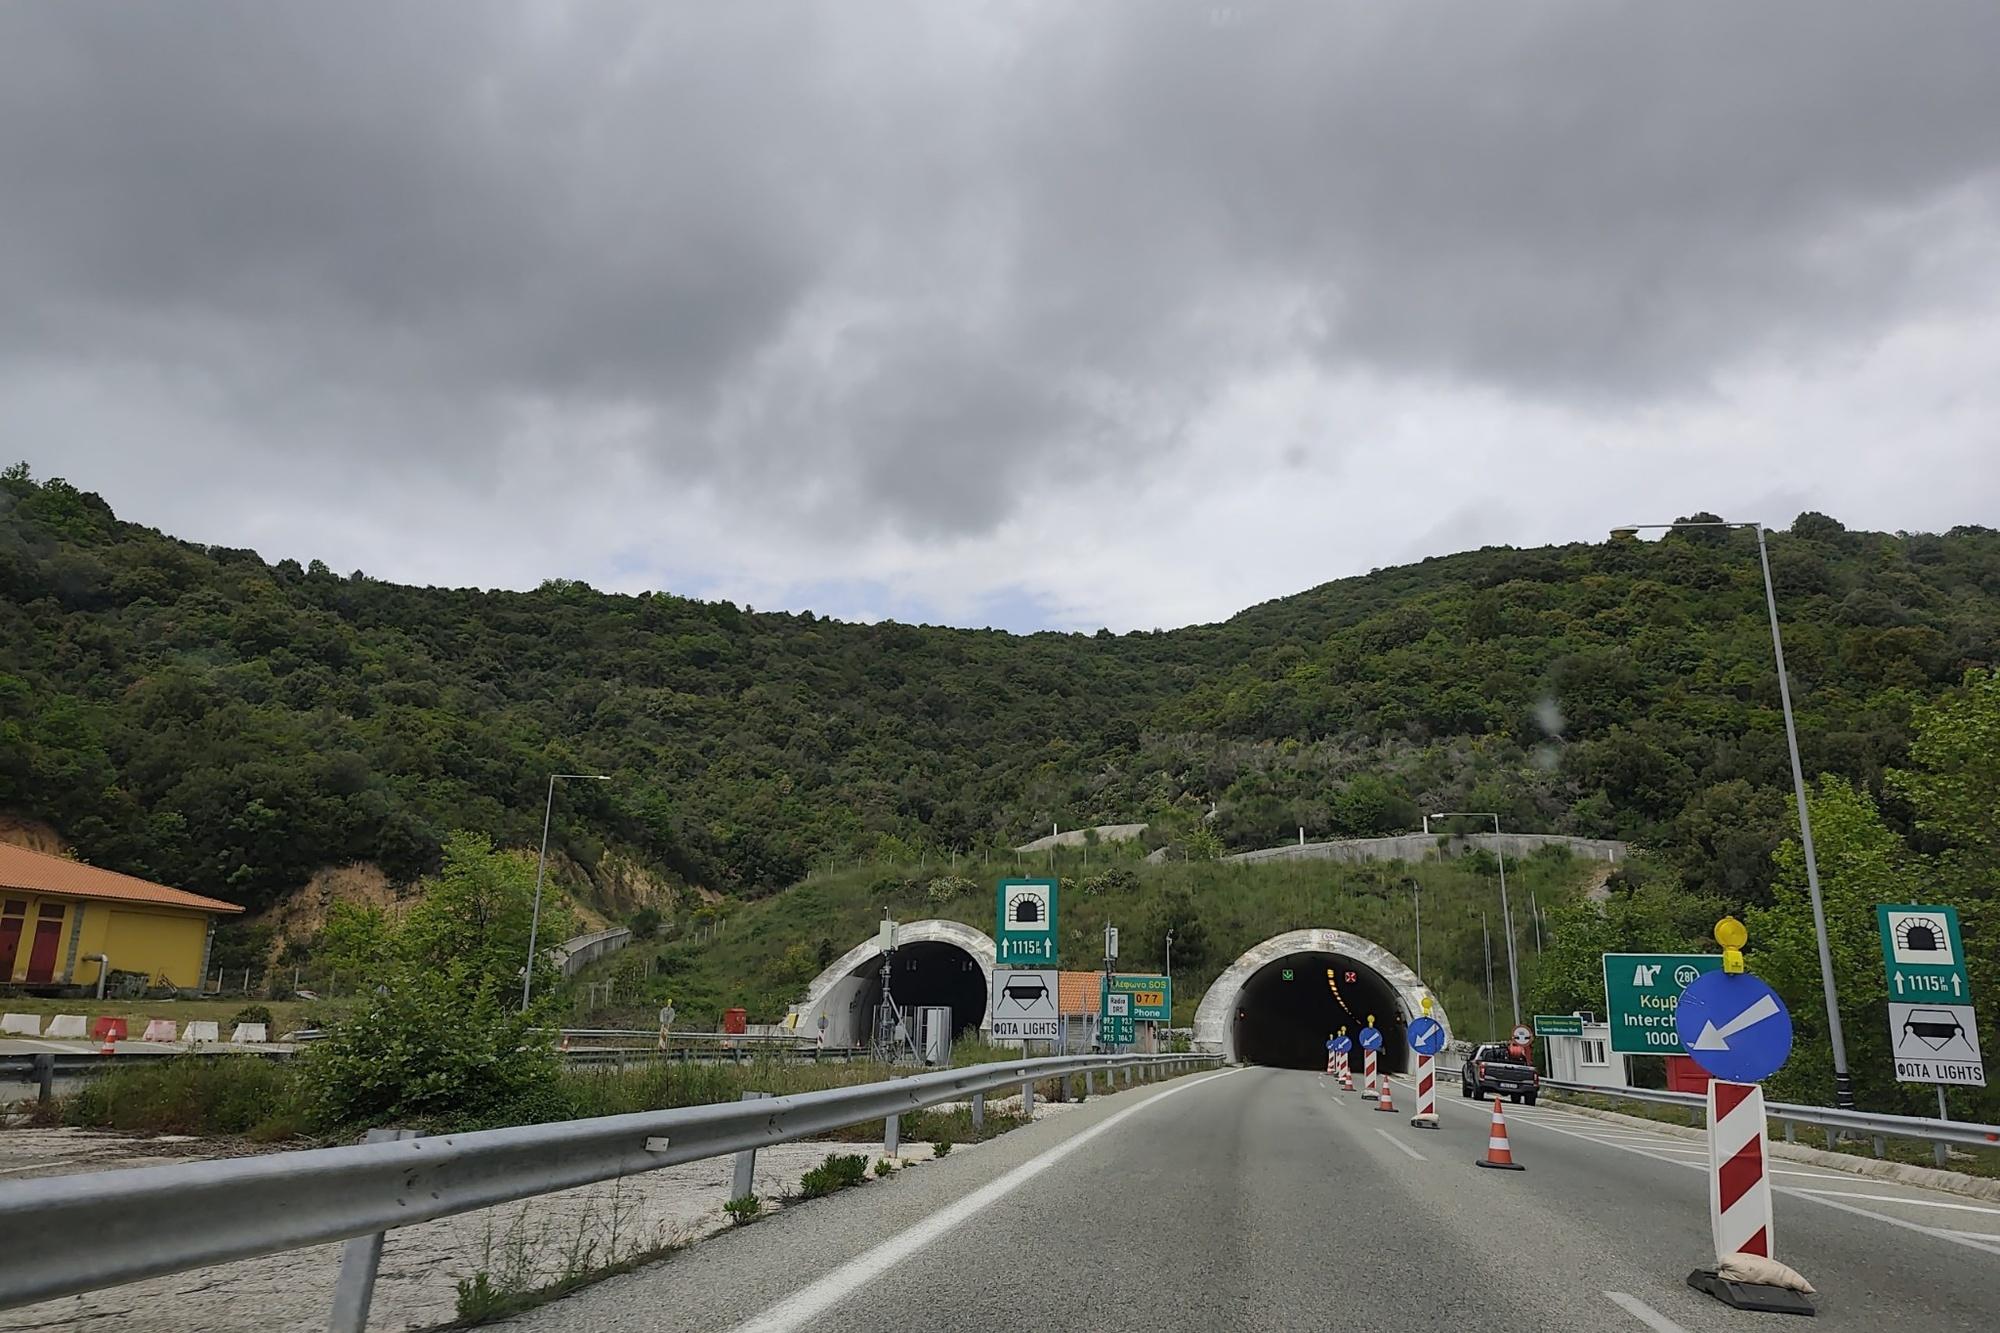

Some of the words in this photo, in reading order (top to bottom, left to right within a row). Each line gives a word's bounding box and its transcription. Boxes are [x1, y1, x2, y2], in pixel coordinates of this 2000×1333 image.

[1012, 940, 1035, 954] 1115
[1149, 980, 1167, 989] SOS
[1908, 975, 1940, 991] 1115
[1640, 994, 1678, 1011] Κόμβ
[1134, 1008, 1161, 1017] Phone
[1624, 1012, 1677, 1027] Interch
[994, 1022, 1019, 1035] ΦΩΤΑ
[1023, 1022, 1058, 1035] LIGHTS
[1645, 1031, 1679, 1046] 1000
[1897, 1063, 1930, 1078] ΦΩΤΑ
[1935, 1064, 1983, 1081] LIGHTS
